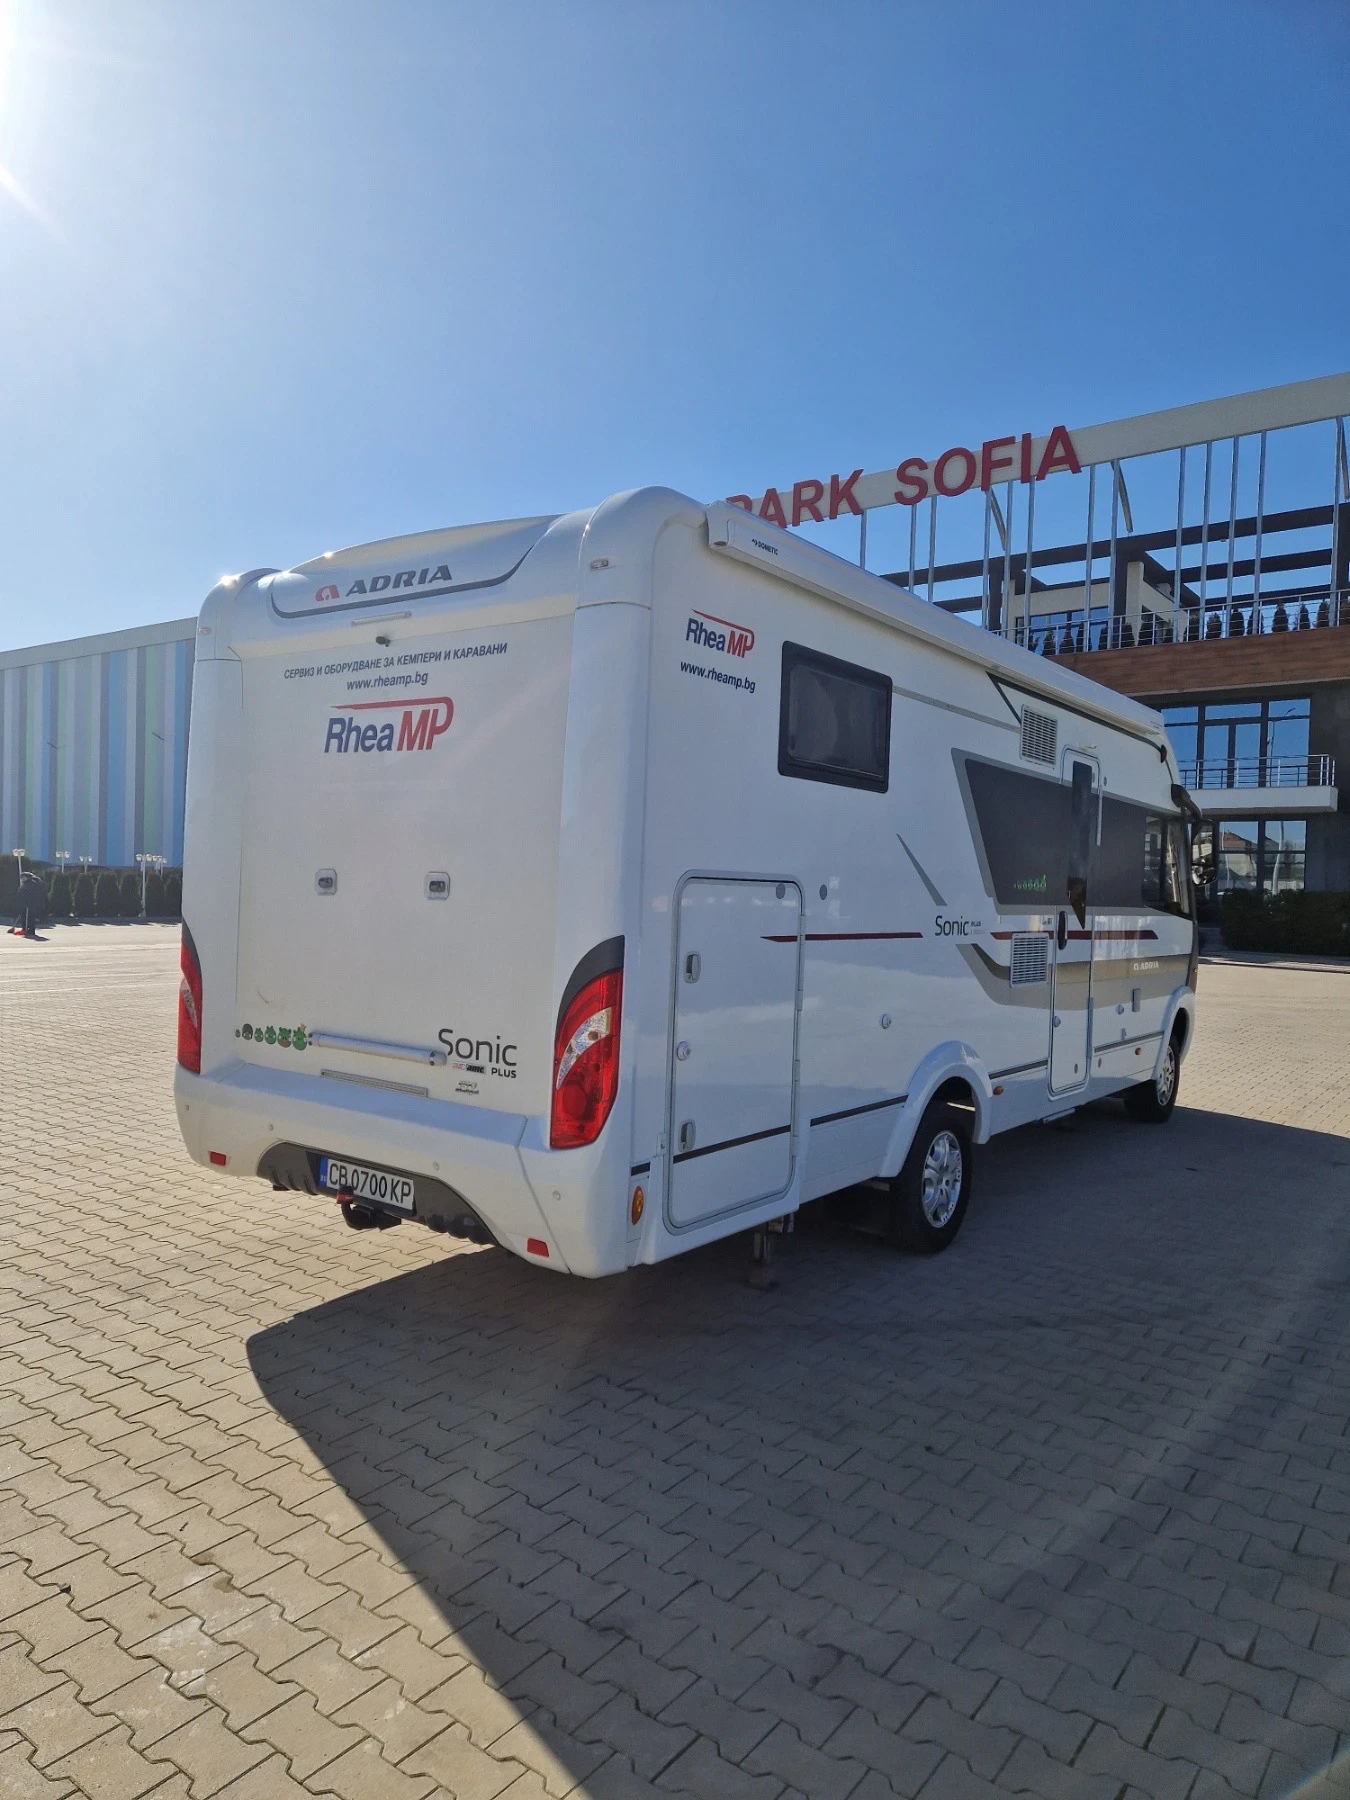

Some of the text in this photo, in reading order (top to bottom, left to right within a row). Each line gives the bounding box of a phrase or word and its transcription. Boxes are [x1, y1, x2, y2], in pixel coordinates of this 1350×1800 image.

[894, 424, 1082, 507] SOFIA
[345, 564, 453, 597] ADRIA
[284, 642, 508, 679] СЕРВИЗ И ОБОРУДВАНЕ ЗА КЕМПЕРИ И КАРАВАНИ
[680, 660, 757, 694] www.rheamp.bg
[346, 670, 429, 691] www.rheamp.bg
[935, 915, 970, 936] Sonic
[438, 1028, 518, 1067] Sonic
[491, 1067, 517, 1079] PLUS
